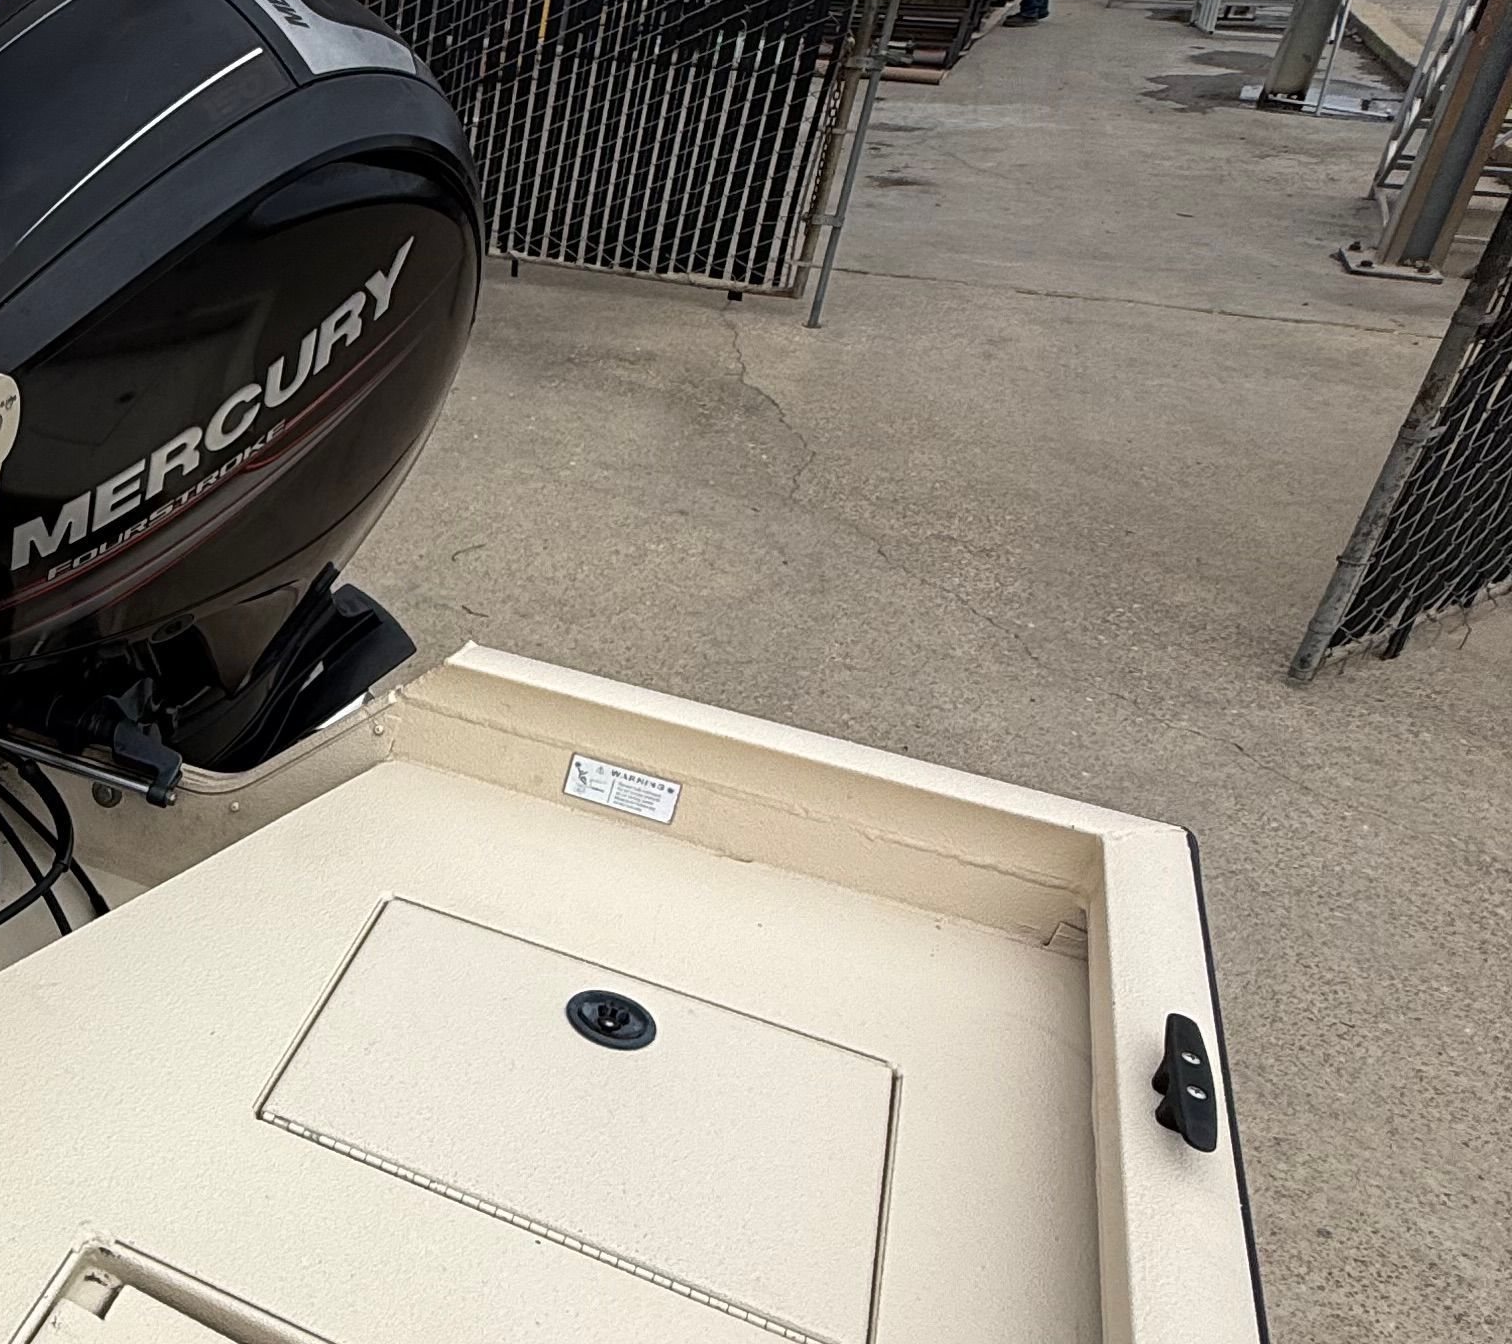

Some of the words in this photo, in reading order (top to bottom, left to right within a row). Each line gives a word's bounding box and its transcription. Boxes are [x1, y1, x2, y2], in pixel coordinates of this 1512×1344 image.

[11, 235, 414, 572] MERCURY
[47, 419, 287, 582] FOURSTROKE
[611, 768, 665, 791] WARNING
